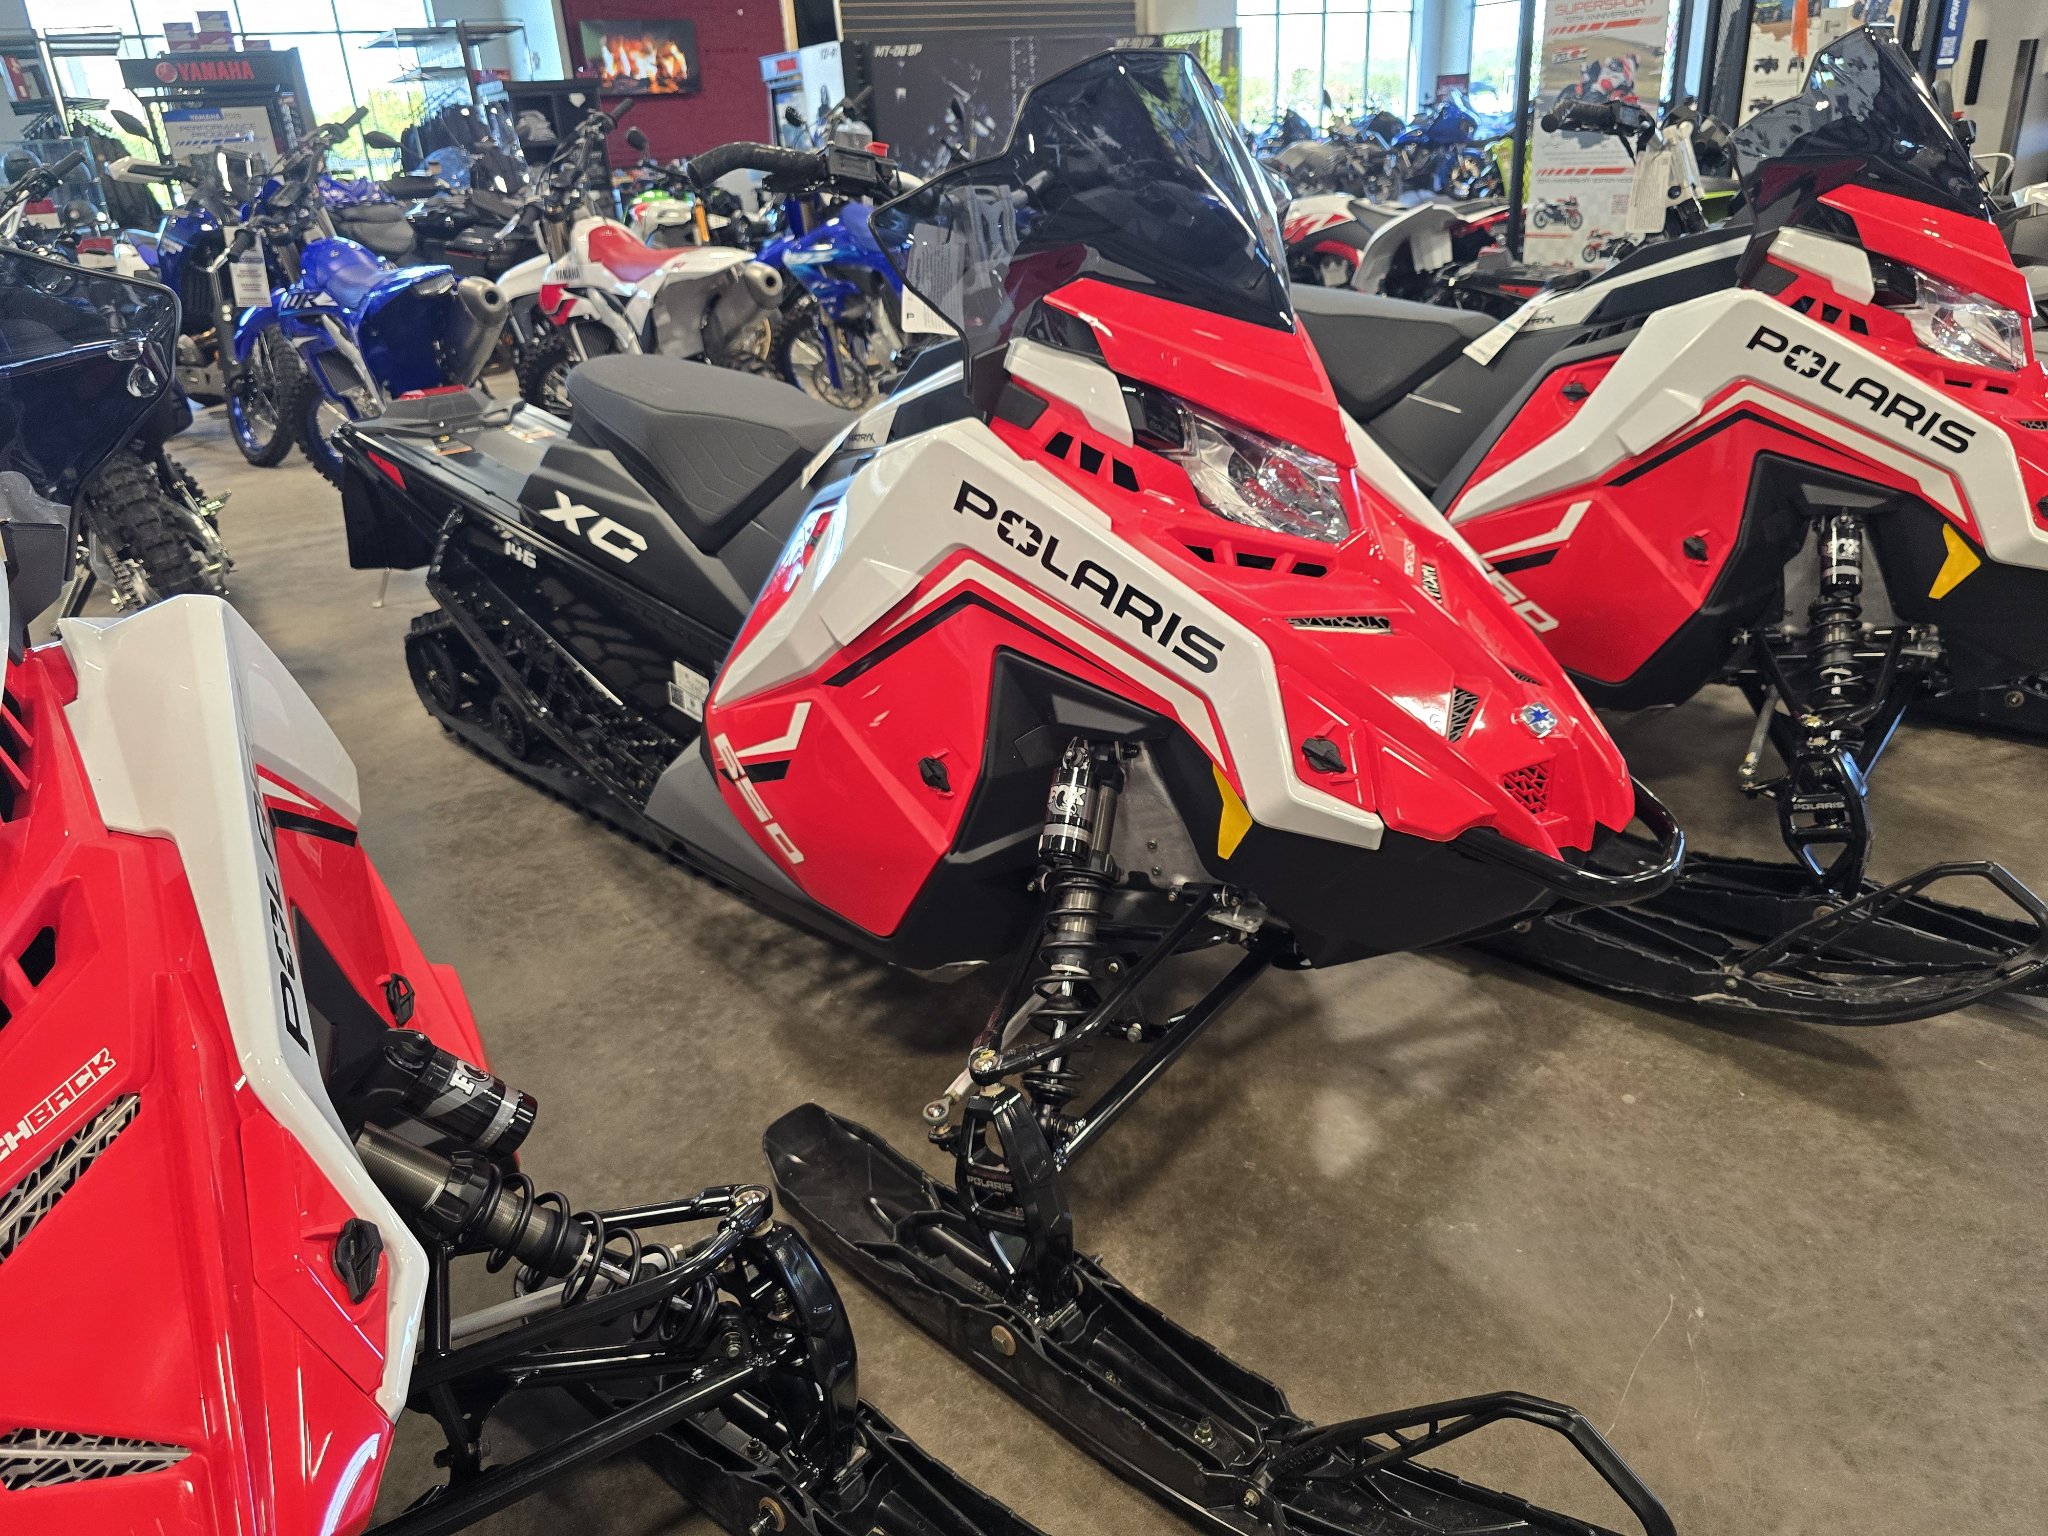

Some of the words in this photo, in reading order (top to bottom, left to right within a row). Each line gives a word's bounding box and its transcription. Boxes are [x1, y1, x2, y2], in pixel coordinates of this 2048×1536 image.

[177, 60, 255, 81] YAMAHA
[556, 266, 580, 280] YAMAHA
[1746, 325, 1977, 454] POLARIS
[539, 489, 648, 564] XC
[504, 540, 537, 569] 146
[953, 480, 1226, 674] POLARIS
[1481, 558, 1560, 633] 50
[713, 732, 805, 865] 650
[1793, 801, 1846, 811] POLARIS
[449, 1059, 492, 1097] FO
[966, 1175, 1014, 1193] POLARIS
